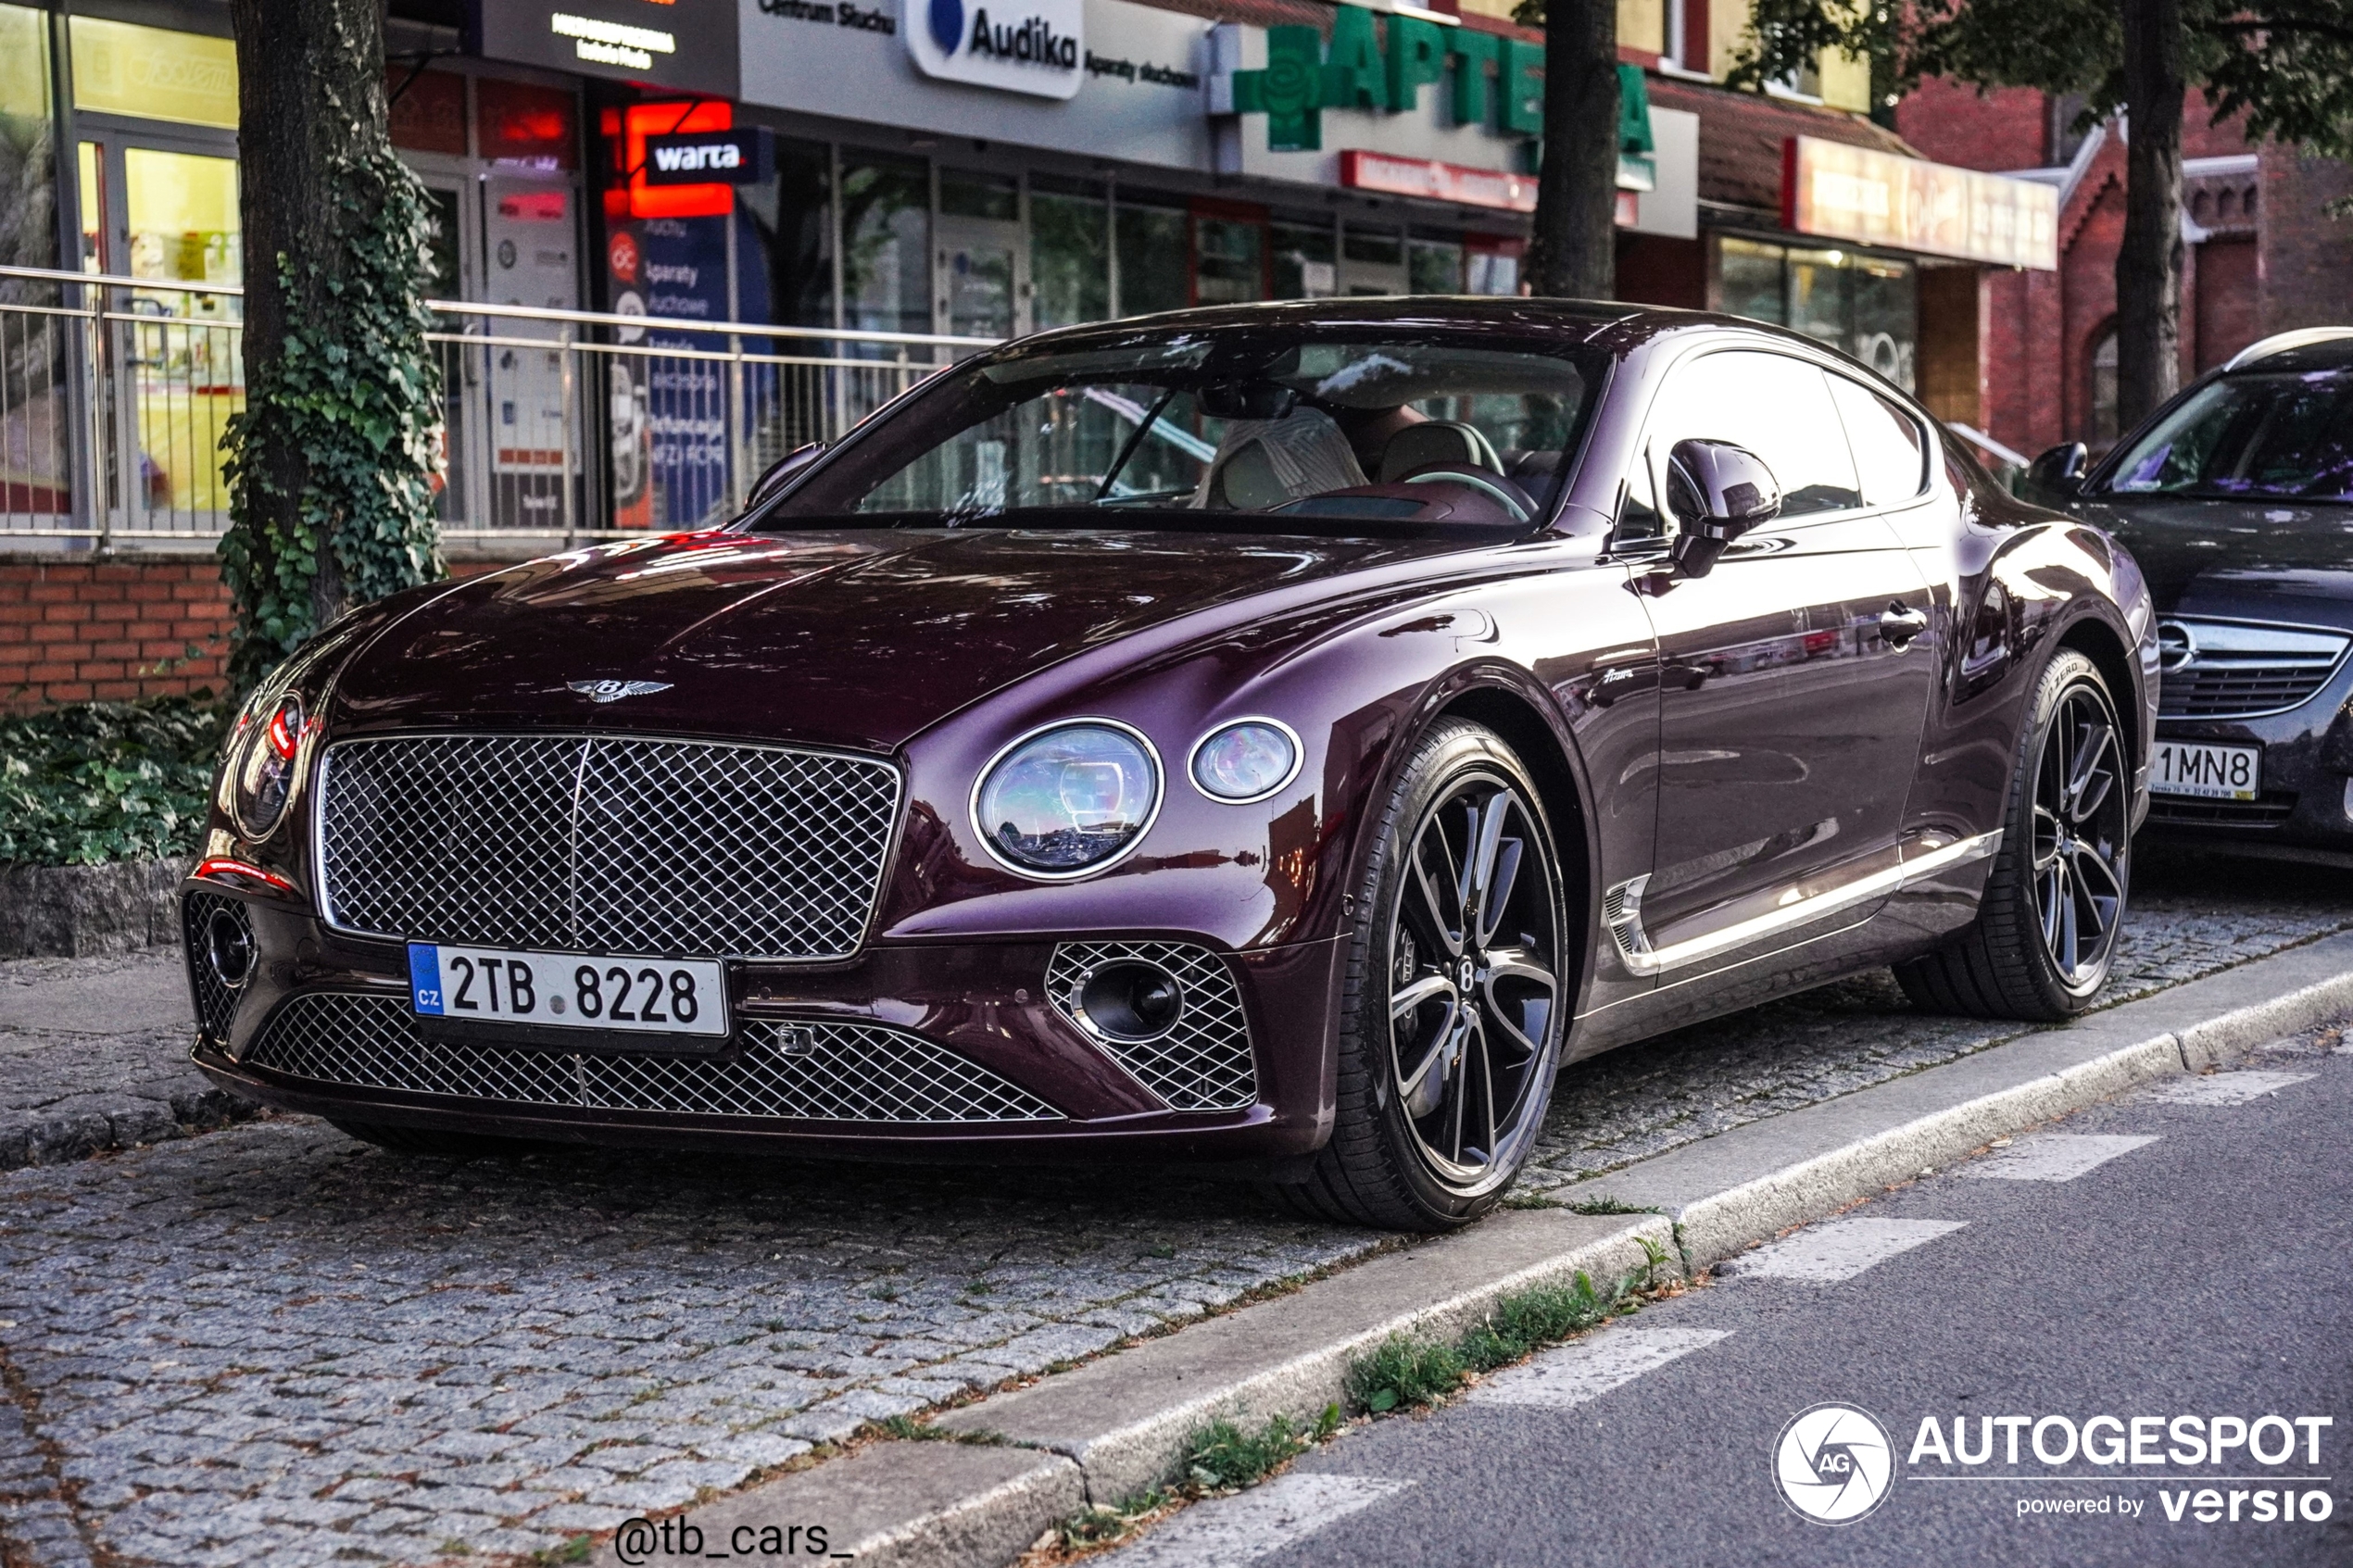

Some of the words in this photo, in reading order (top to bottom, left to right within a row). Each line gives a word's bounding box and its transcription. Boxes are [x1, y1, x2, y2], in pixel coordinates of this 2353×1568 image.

[970, 8, 1076, 69] Audika
[1327, 3, 1655, 153] APTEA
[2054, 662, 2078, 689] ZERO
[2160, 746, 2249, 787] 1MN8
[418, 989, 440, 1007] CZ
[450, 956, 536, 1014] 2TB
[574, 964, 698, 1022] 8228
